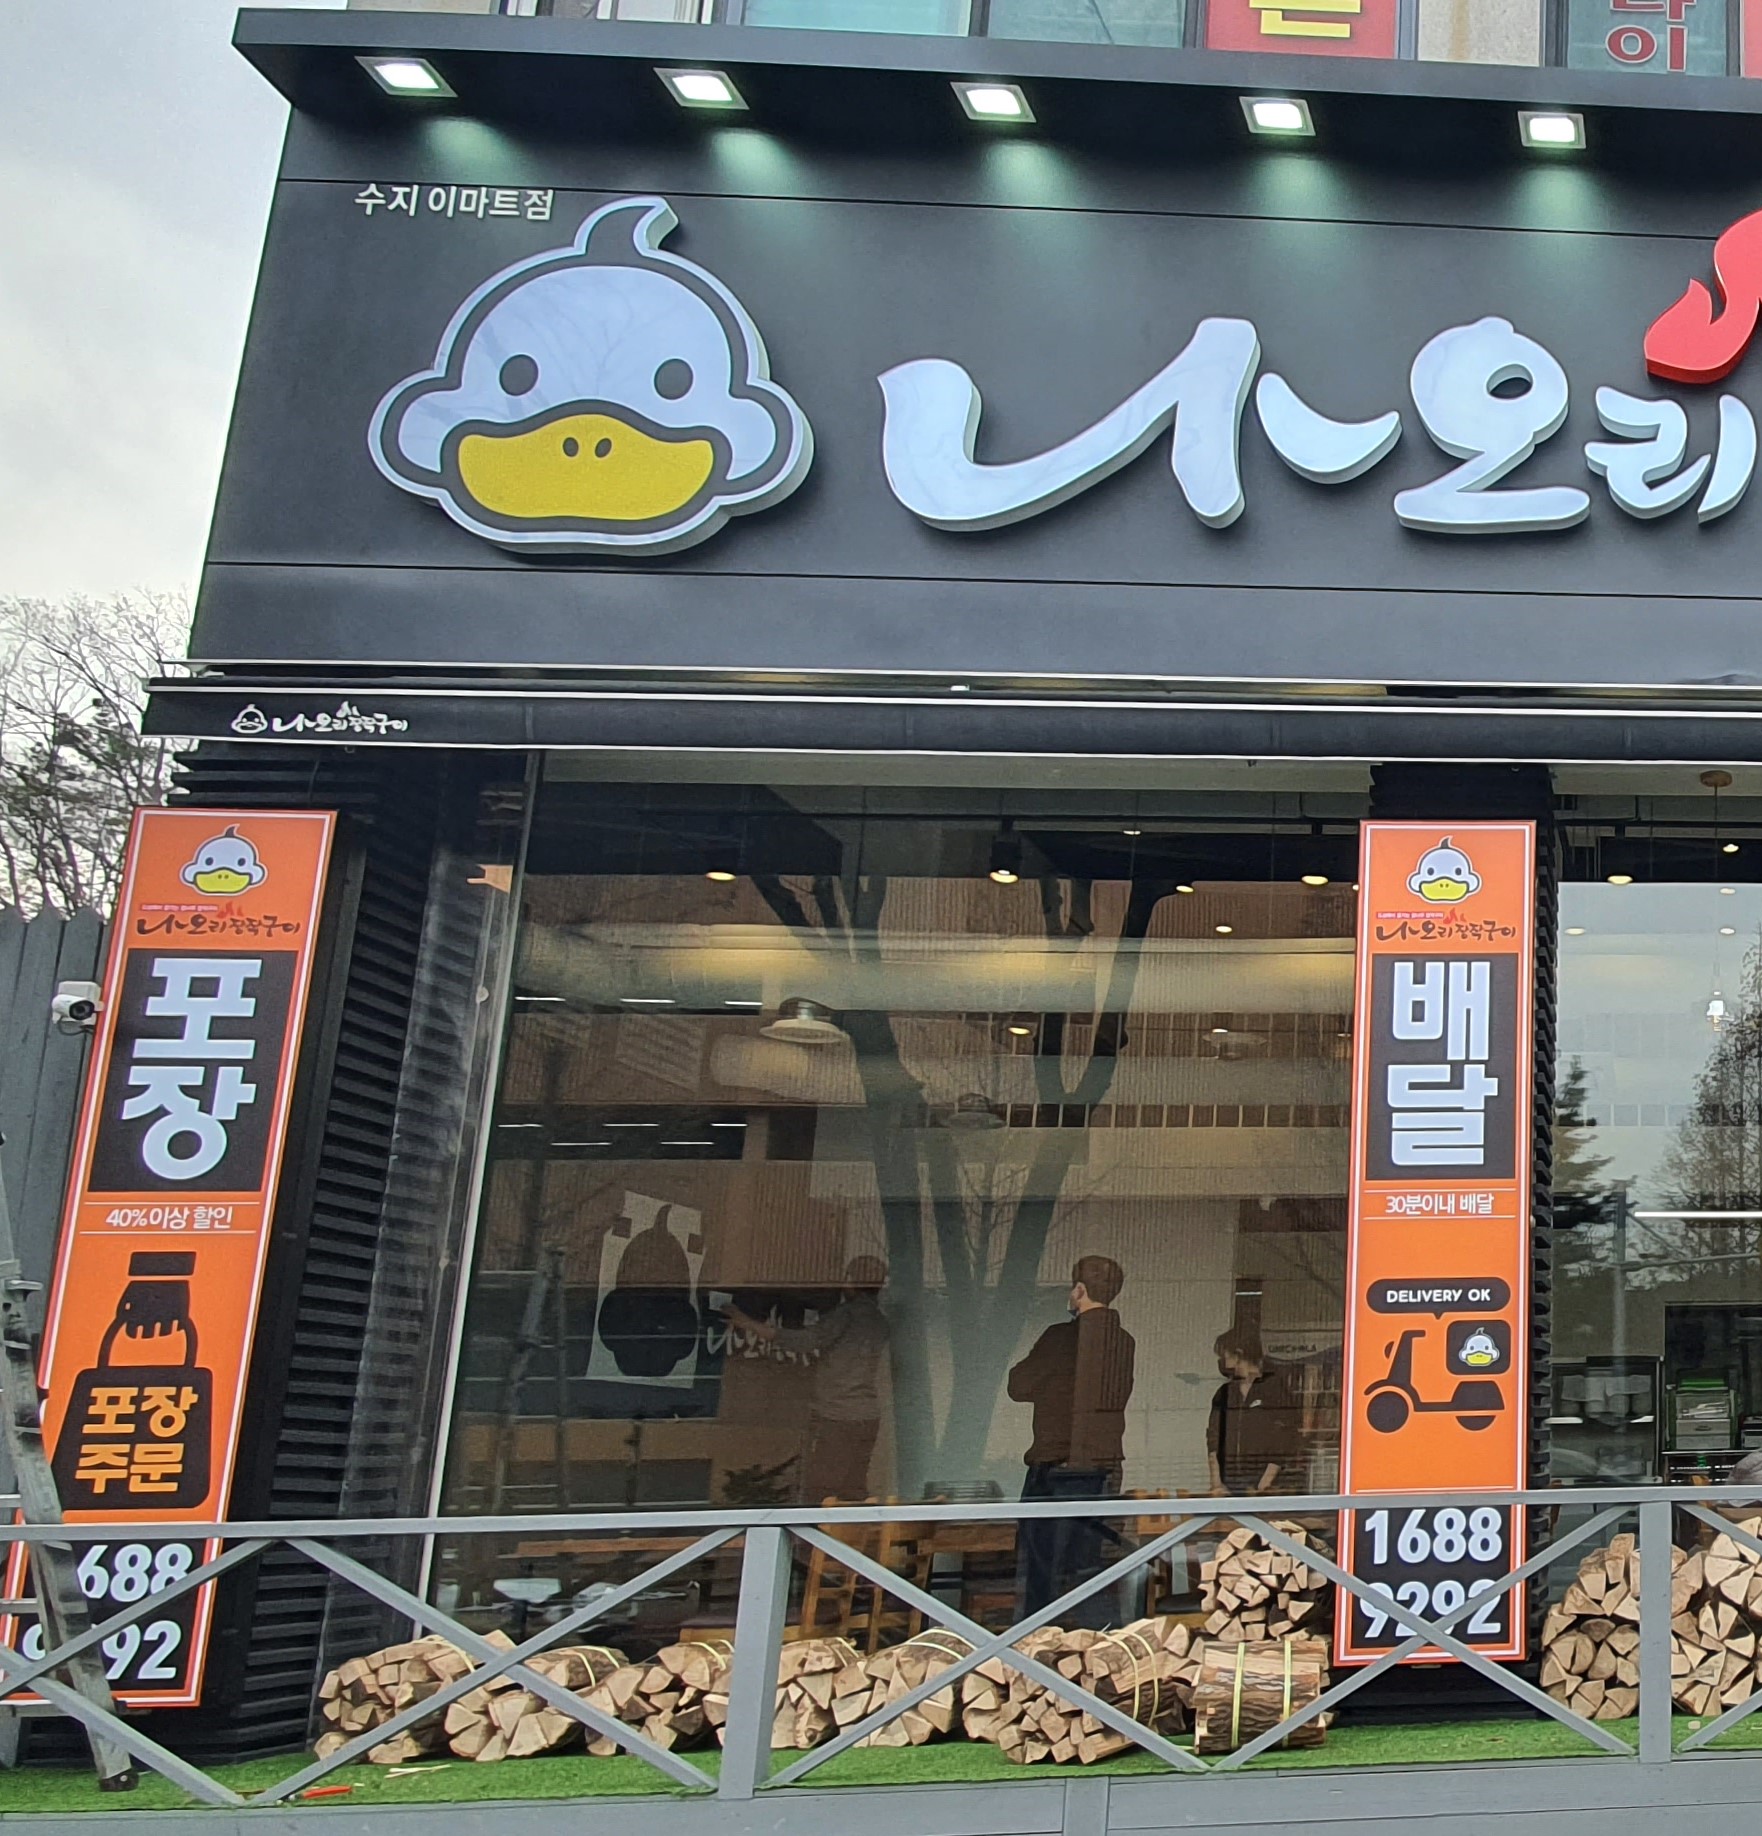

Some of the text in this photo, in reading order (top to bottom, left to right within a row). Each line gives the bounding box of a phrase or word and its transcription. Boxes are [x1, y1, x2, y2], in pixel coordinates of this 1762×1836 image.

[354, 183, 555, 221] 수지 이마트점
[137, 914, 300, 938] 나오리장작구이
[1376, 920, 1516, 941] 나오리장작구이
[121, 957, 262, 1180] 포장
[1387, 961, 1499, 1166] 배달
[105, 1205, 233, 1230] 40%이상 할인
[1385, 1193, 1494, 1215] 30분이내 배달
[1386, 1288, 1491, 1303] DELIVERY OK
[82, 1385, 198, 1437] 포장
[75, 1442, 185, 1494] 주문
[1364, 1506, 1502, 1565] 1688
[77, 1543, 193, 1602] 688
[1360, 1578, 1501, 1639] 9292
